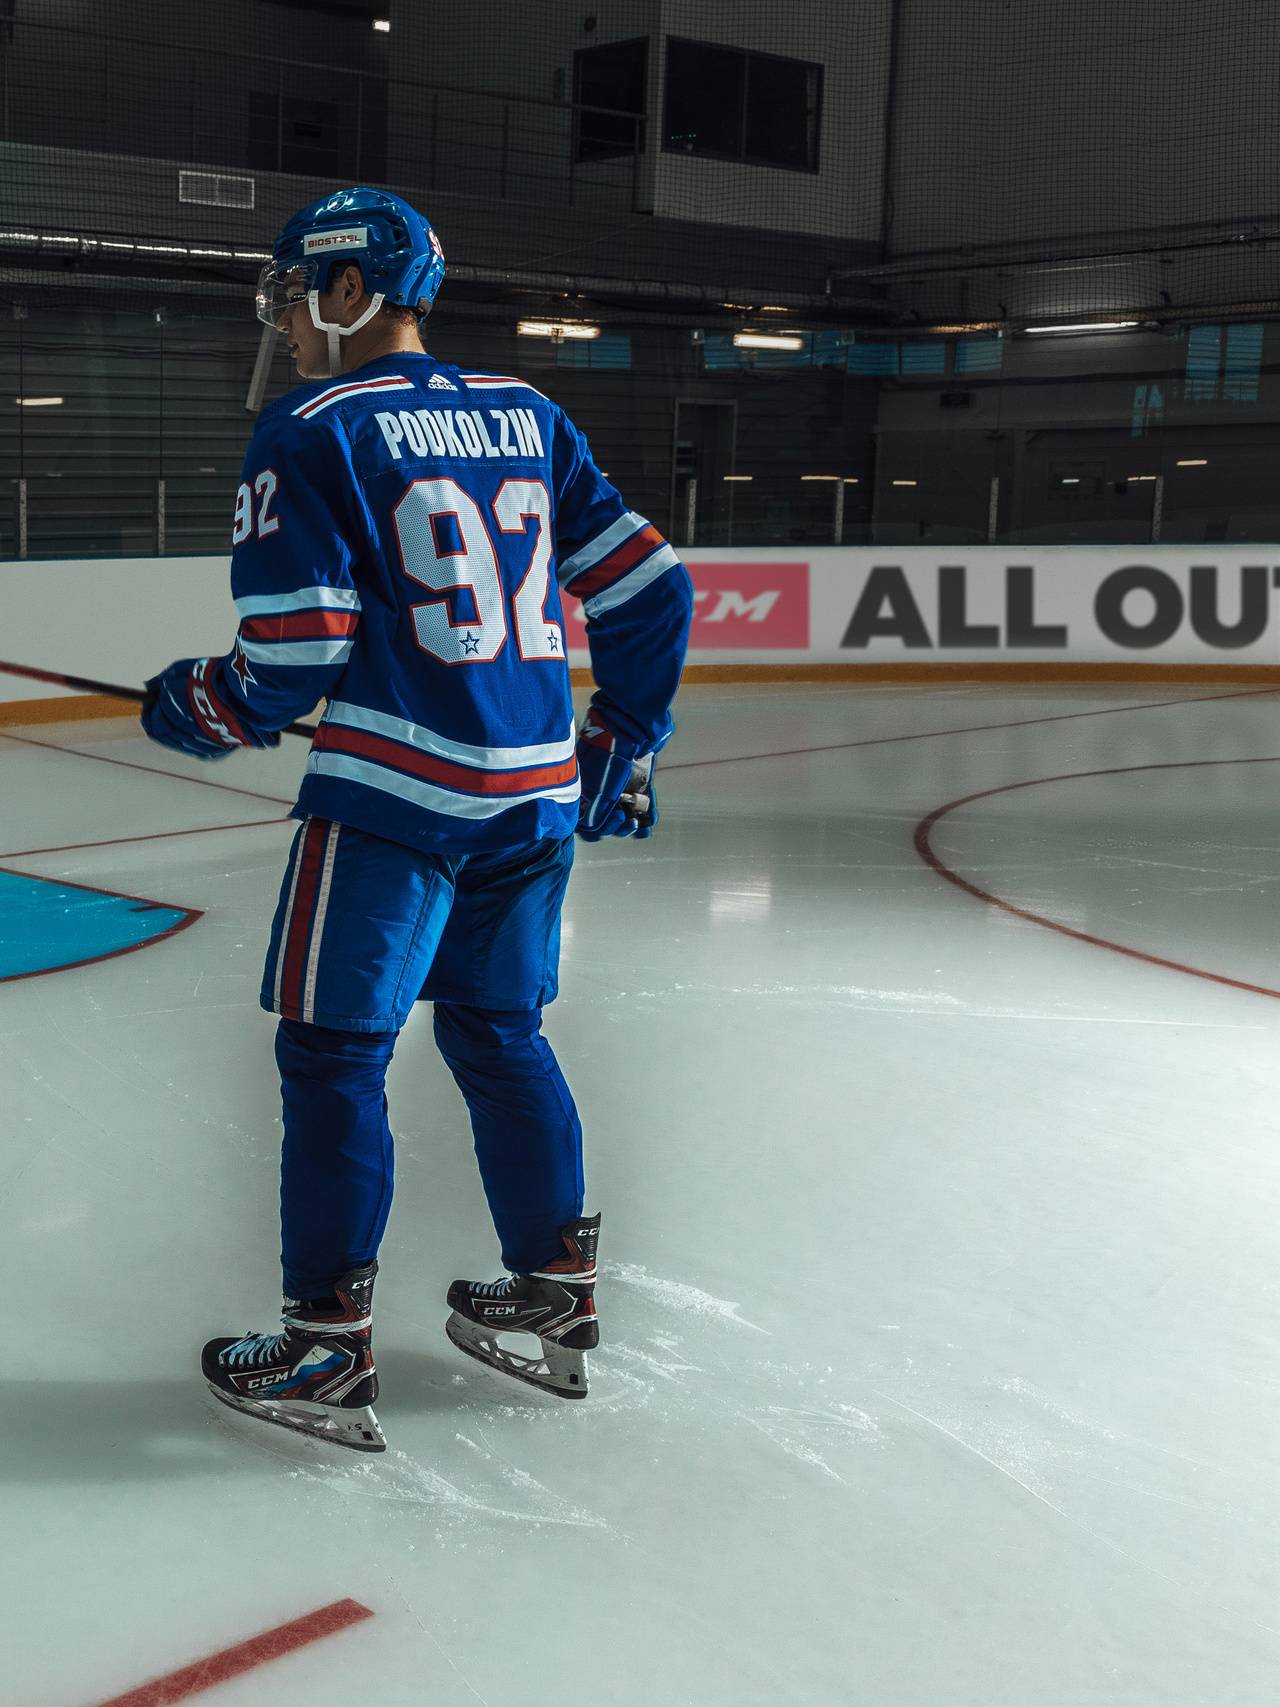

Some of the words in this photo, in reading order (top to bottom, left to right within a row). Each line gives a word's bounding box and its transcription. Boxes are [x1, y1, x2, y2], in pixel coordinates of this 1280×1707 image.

[307, 234, 362, 248] BIOSTEEL
[428, 382, 458, 391] adidas
[374, 408, 545, 460] PODKOLZIN
[232, 467, 281, 546] 92
[392, 477, 566, 666] 92
[839, 565, 1068, 649] ALL
[1094, 564, 1280, 650] OU
[483, 1306, 516, 1316] CCM
[248, 1371, 289, 1390] CCM
